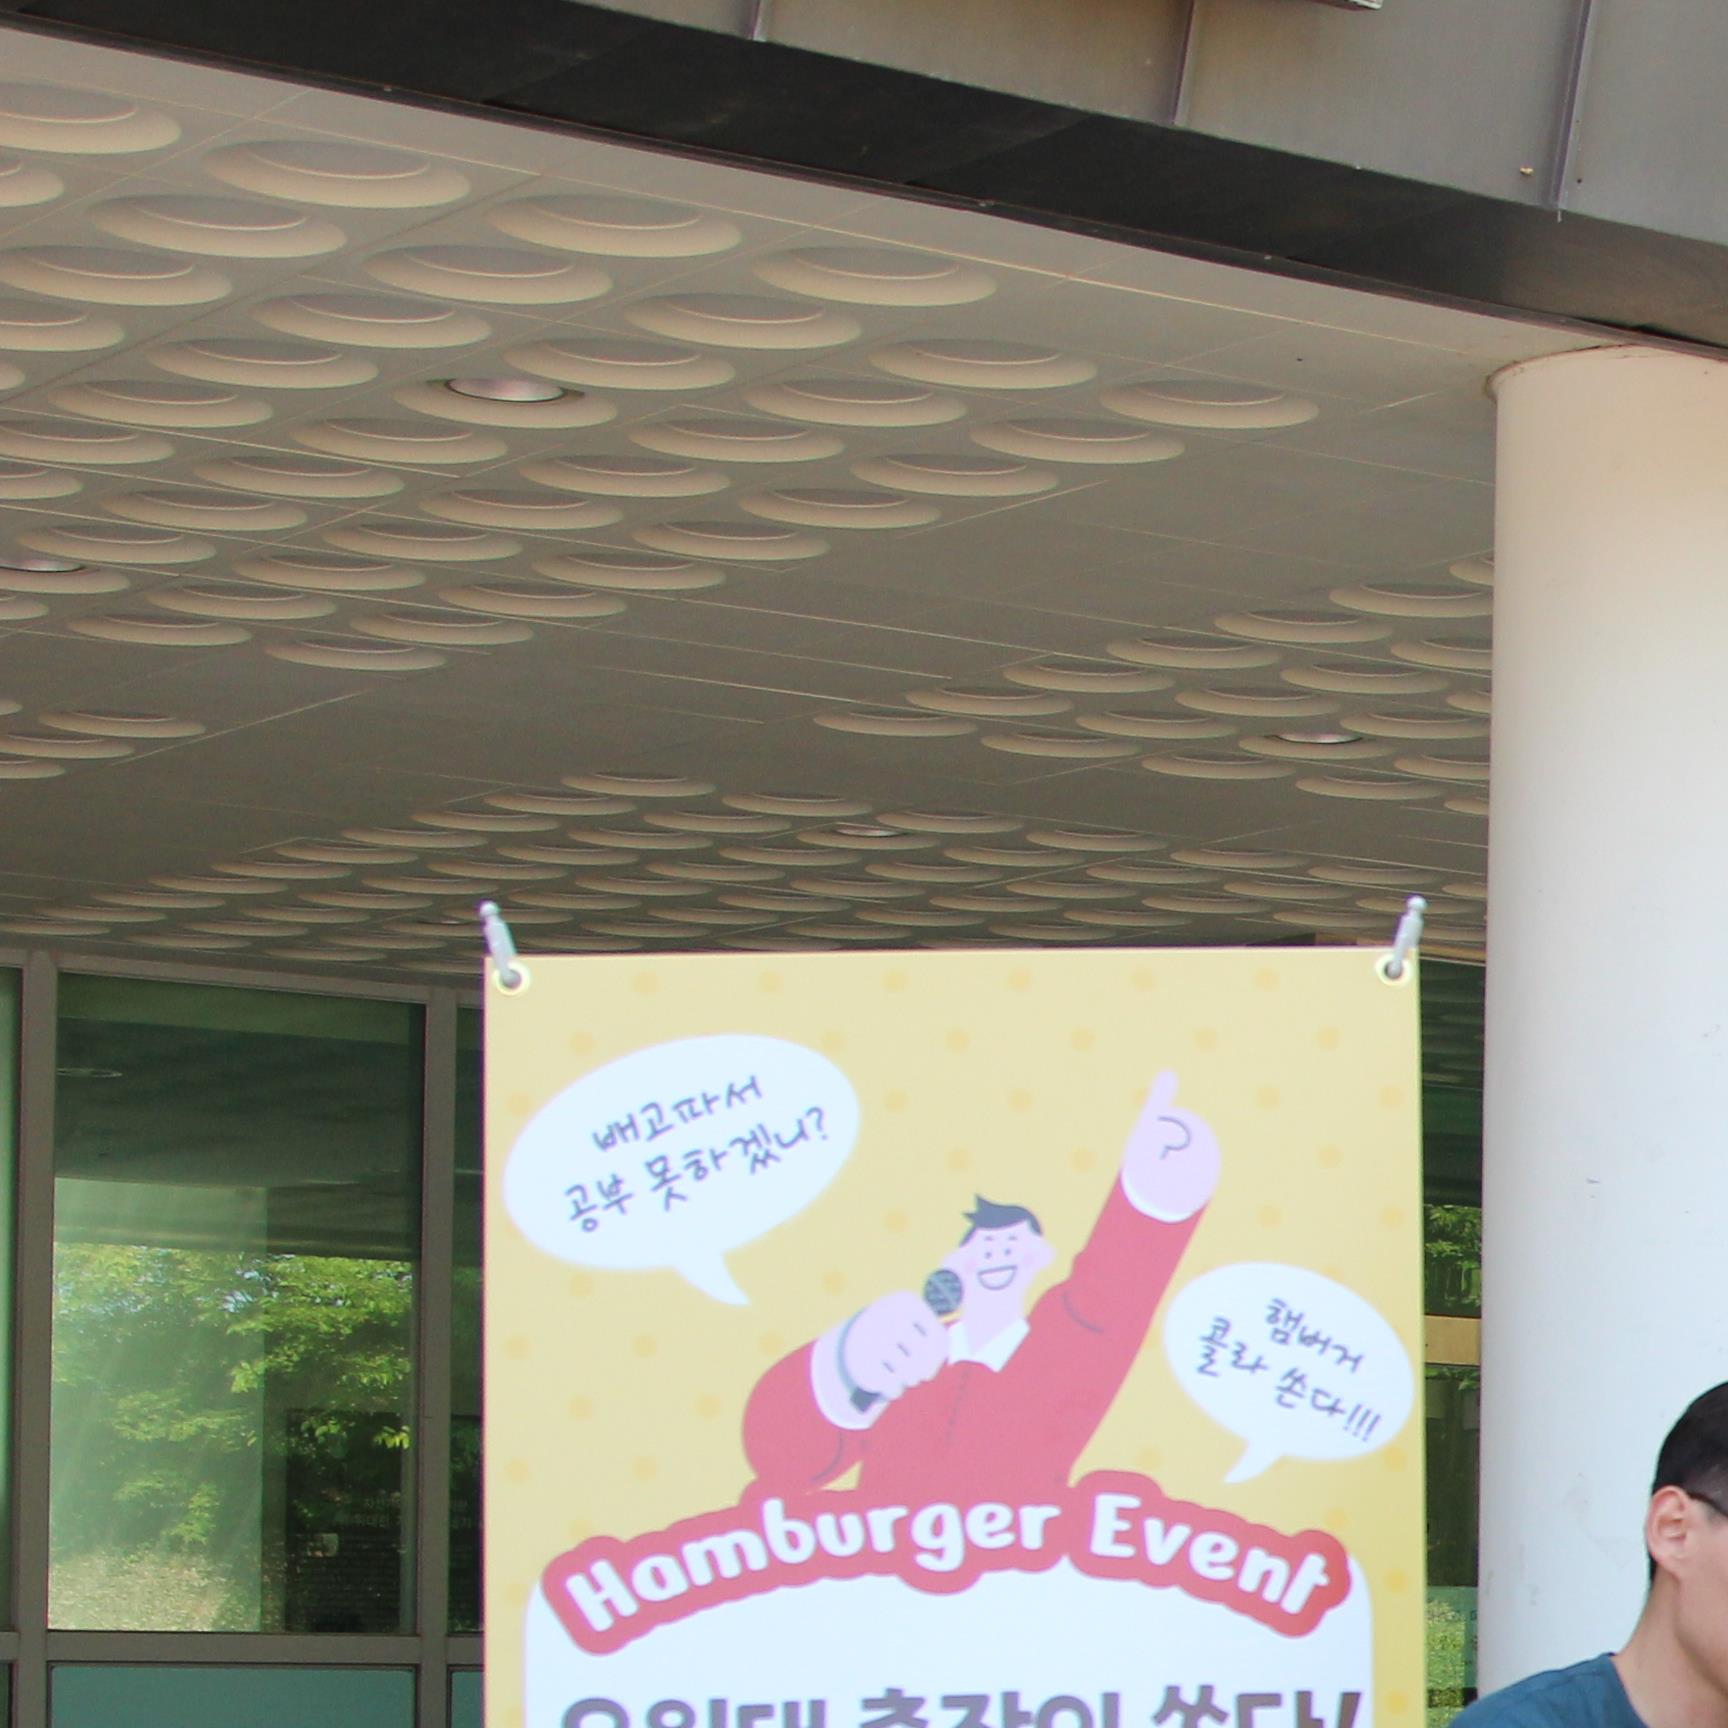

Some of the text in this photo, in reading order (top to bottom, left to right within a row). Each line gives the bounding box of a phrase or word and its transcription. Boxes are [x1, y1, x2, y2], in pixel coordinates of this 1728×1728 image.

[592, 1075, 763, 1152] 배고파서
[564, 1173, 634, 1233] 공부
[1265, 1298, 1364, 1374] 햄버거
[1197, 1315, 1382, 1442] 콜라 쏜다!!!
[565, 1493, 1330, 1633] Hamburger Event
